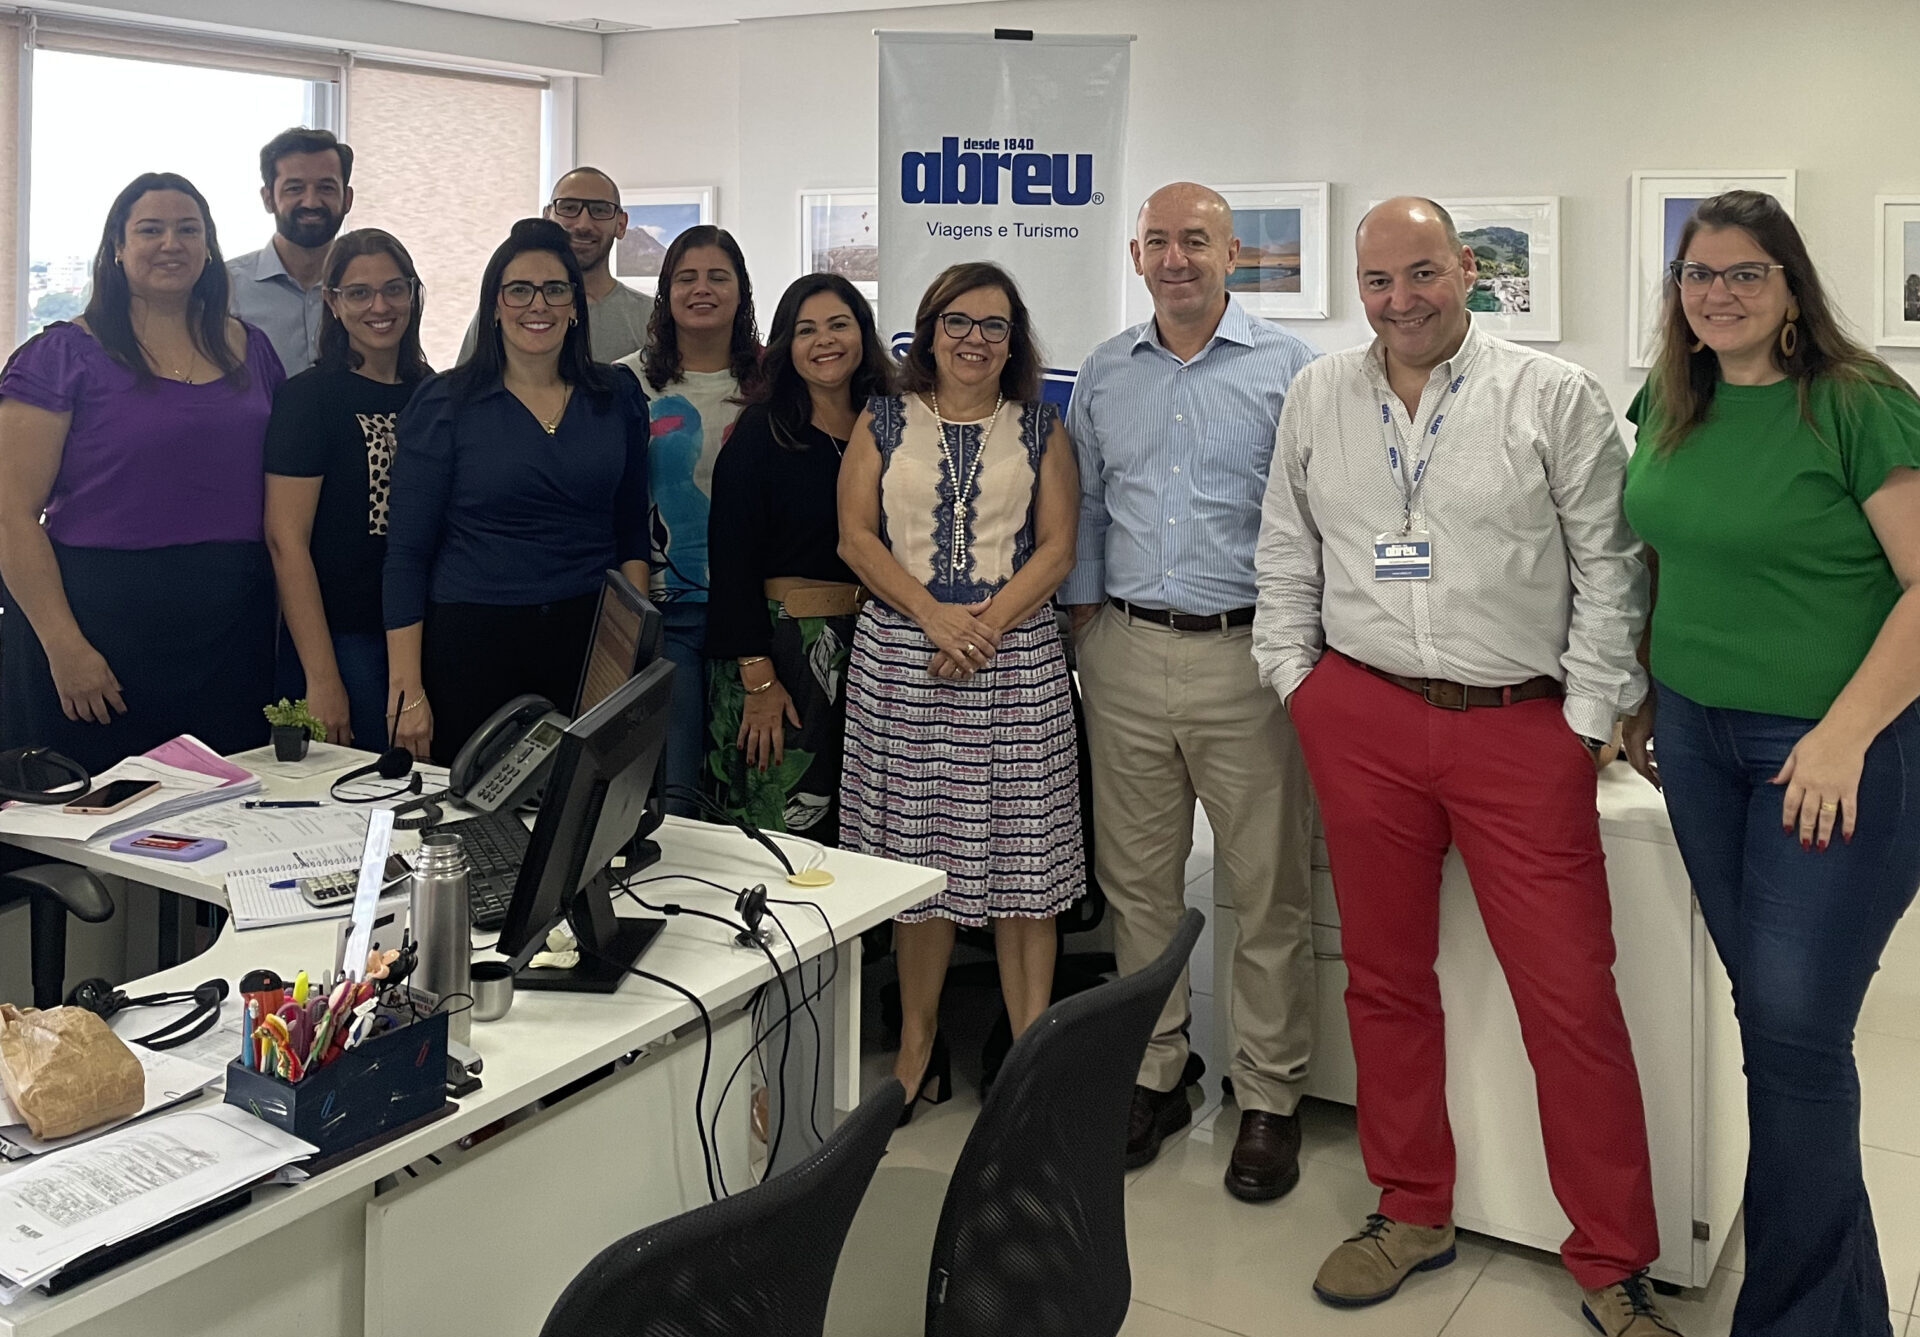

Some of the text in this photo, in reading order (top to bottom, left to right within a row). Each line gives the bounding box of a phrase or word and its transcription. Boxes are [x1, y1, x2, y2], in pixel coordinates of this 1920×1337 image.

[963, 138, 1034, 150] desde 1840
[901, 136, 1093, 206] abreu
[926, 221, 1079, 240] Viagens e Turismo
